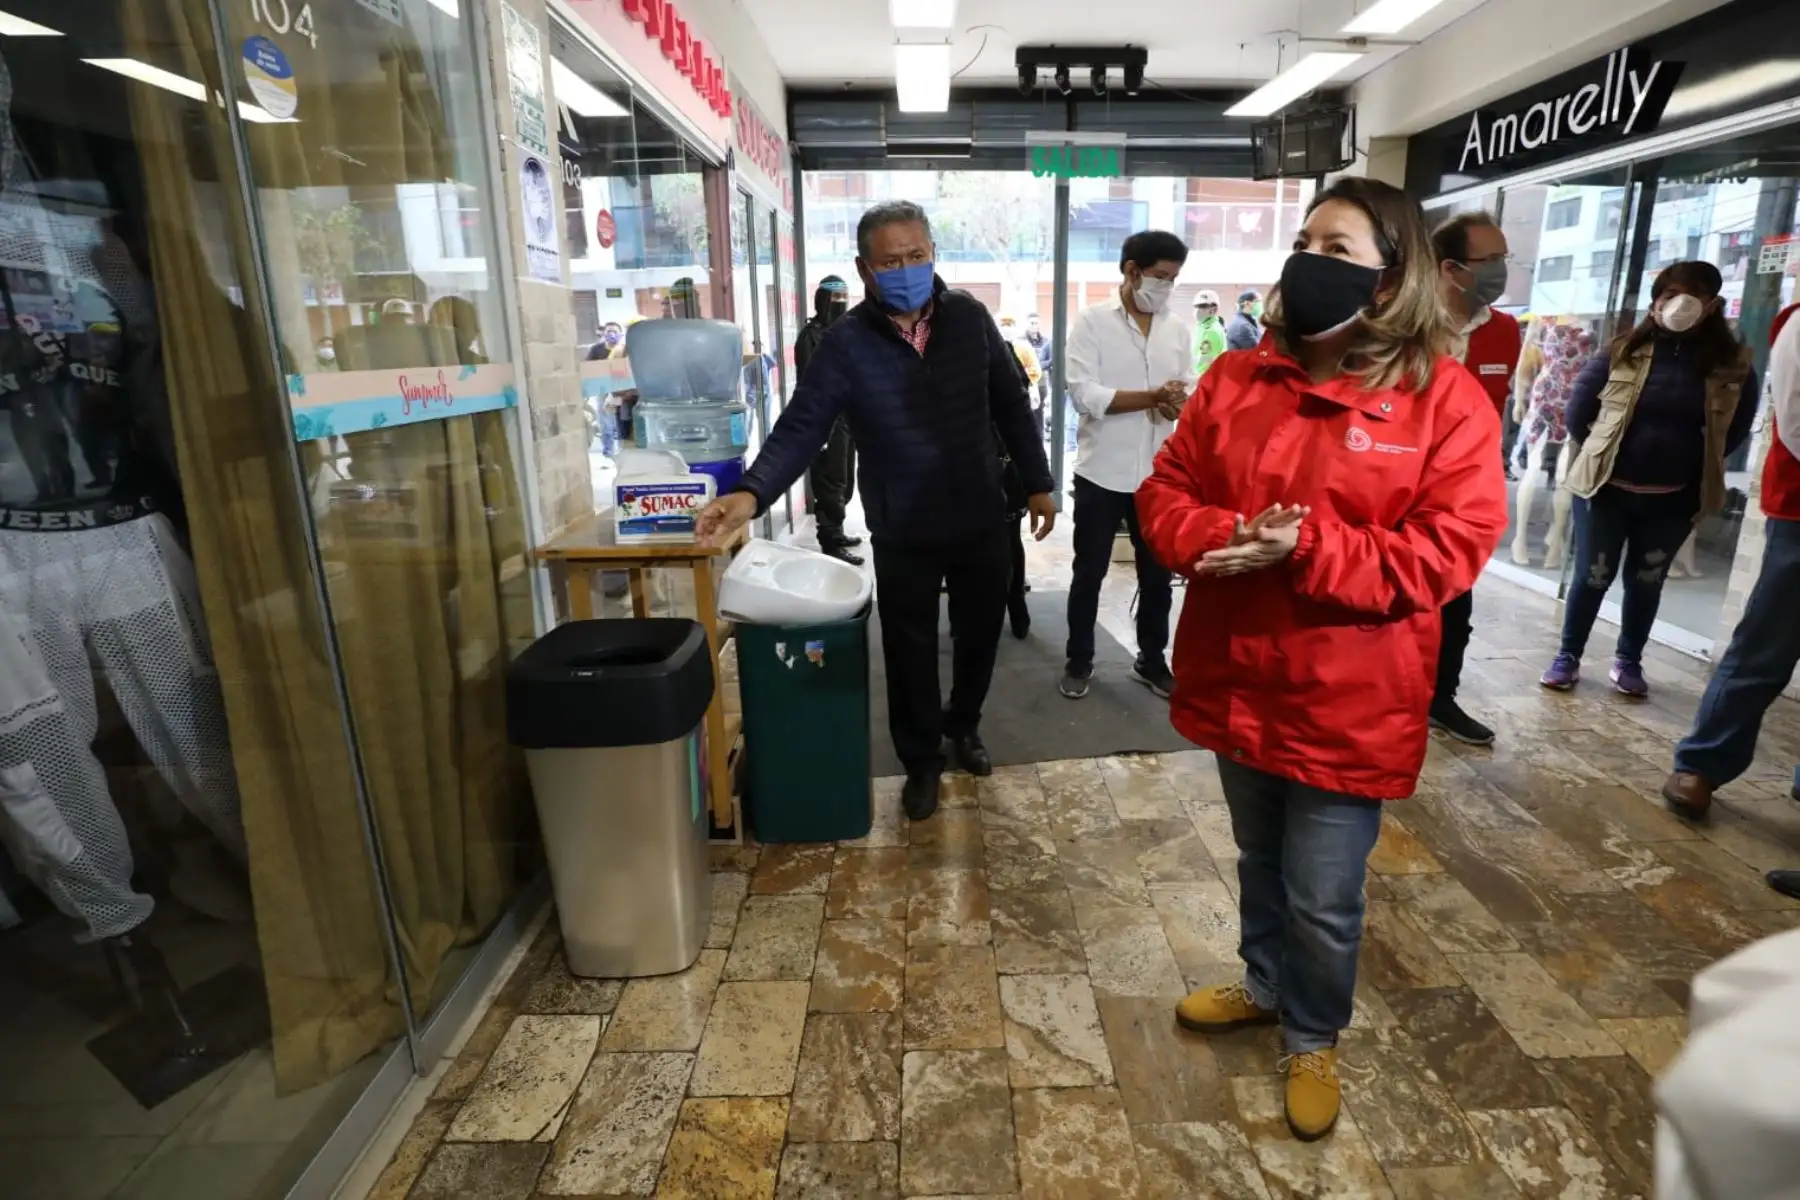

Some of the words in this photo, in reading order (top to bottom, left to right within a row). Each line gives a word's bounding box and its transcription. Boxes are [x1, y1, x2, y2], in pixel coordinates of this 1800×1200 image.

[1458, 47, 1662, 171] Amarelly
[1031, 144, 1120, 178] SALIDA
[398, 369, 454, 416] Summer
[641, 494, 697, 514] SUMAC
